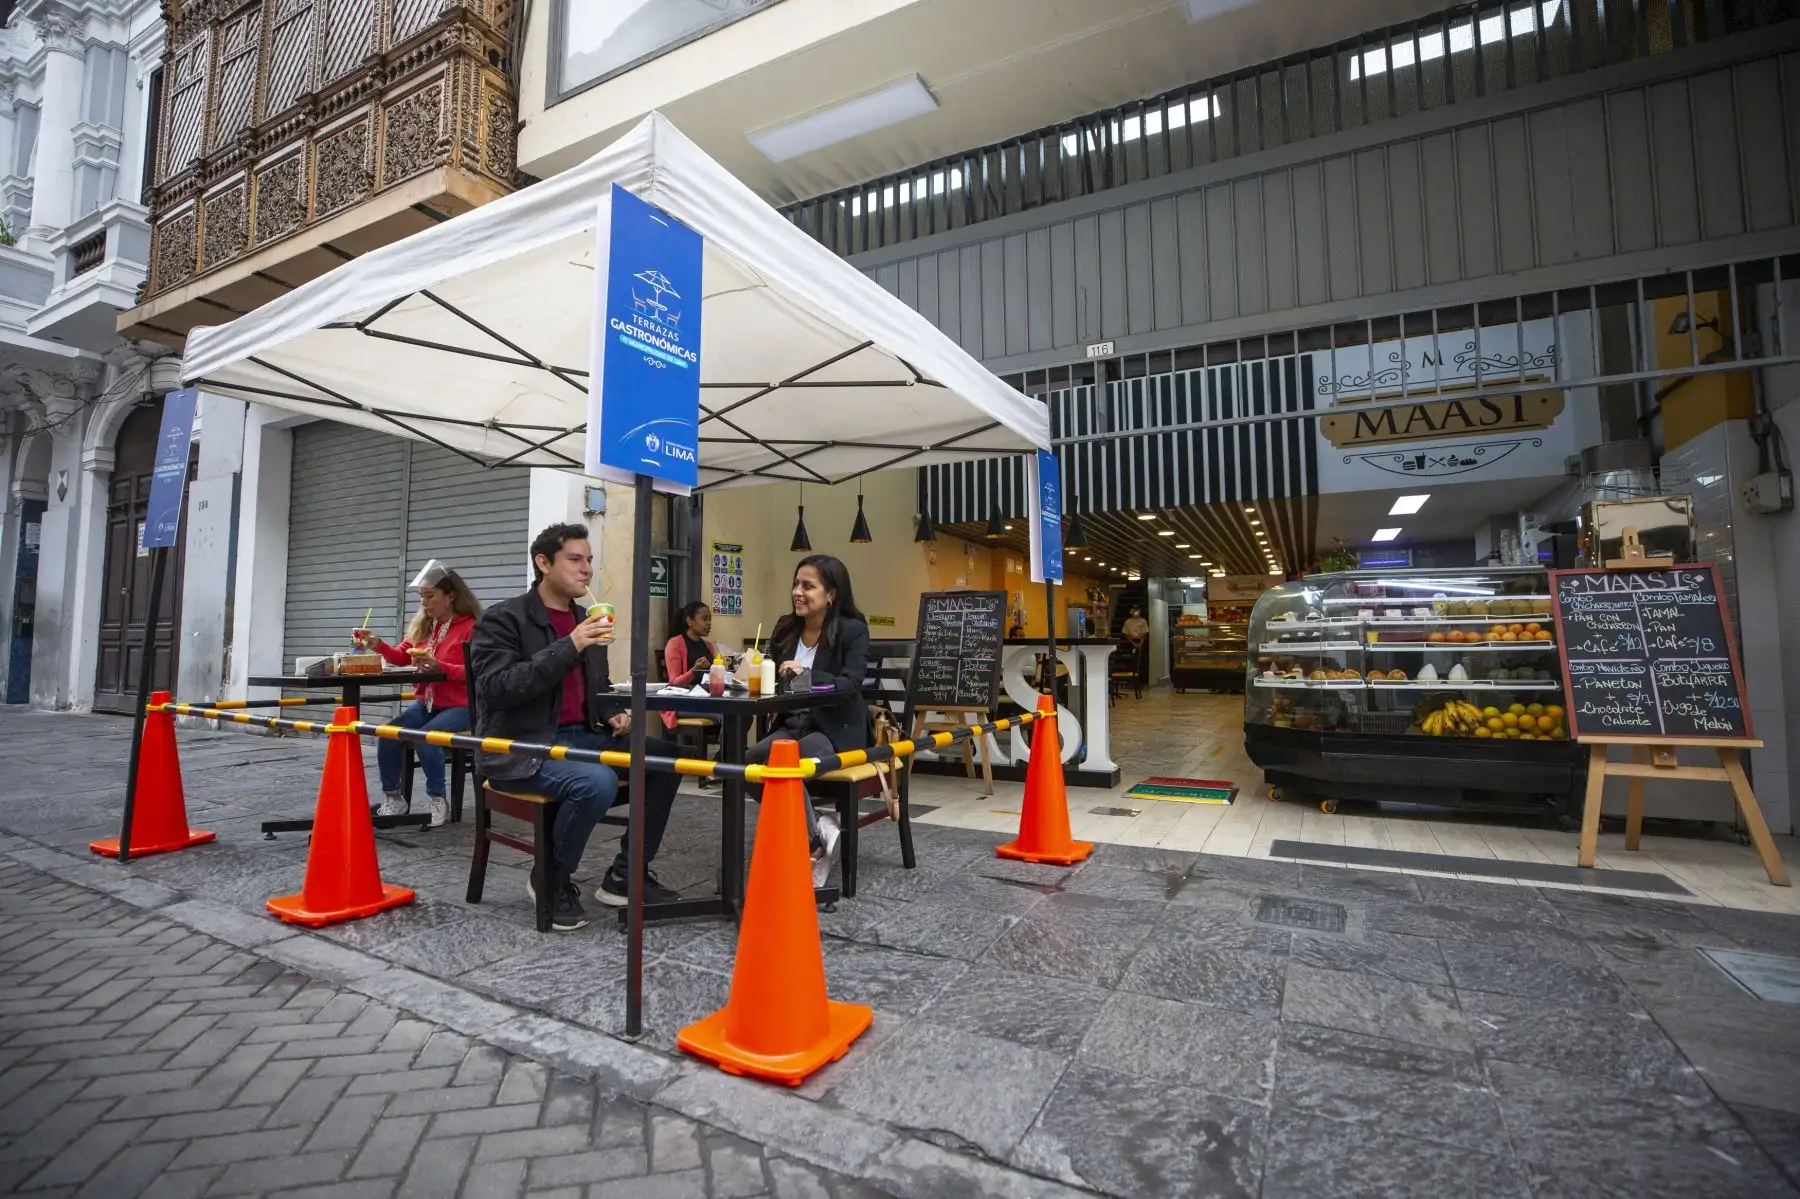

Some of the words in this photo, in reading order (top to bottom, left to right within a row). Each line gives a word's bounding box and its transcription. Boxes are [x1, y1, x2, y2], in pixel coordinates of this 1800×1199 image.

[631, 314, 680, 342] TERRAZAS
[610, 318, 697, 363] GASTRONÓMICAS
[1421, 350, 1445, 369] M
[1352, 394, 1529, 439] MAASI
[665, 445, 695, 463] LIMA
[1584, 570, 1684, 593] MAASI
[1559, 591, 1593, 603] Combo
[1636, 591, 1674, 602] Combo
[1569, 609, 1593, 621] PAN
[1600, 613, 1620, 621] CON
[1641, 606, 1685, 619] TAMAL
[1649, 621, 1676, 632] PAN
[1569, 662, 1595, 672] Combo
[1653, 660, 1689, 672] Combo
[1664, 700, 1693, 715] Jugo
